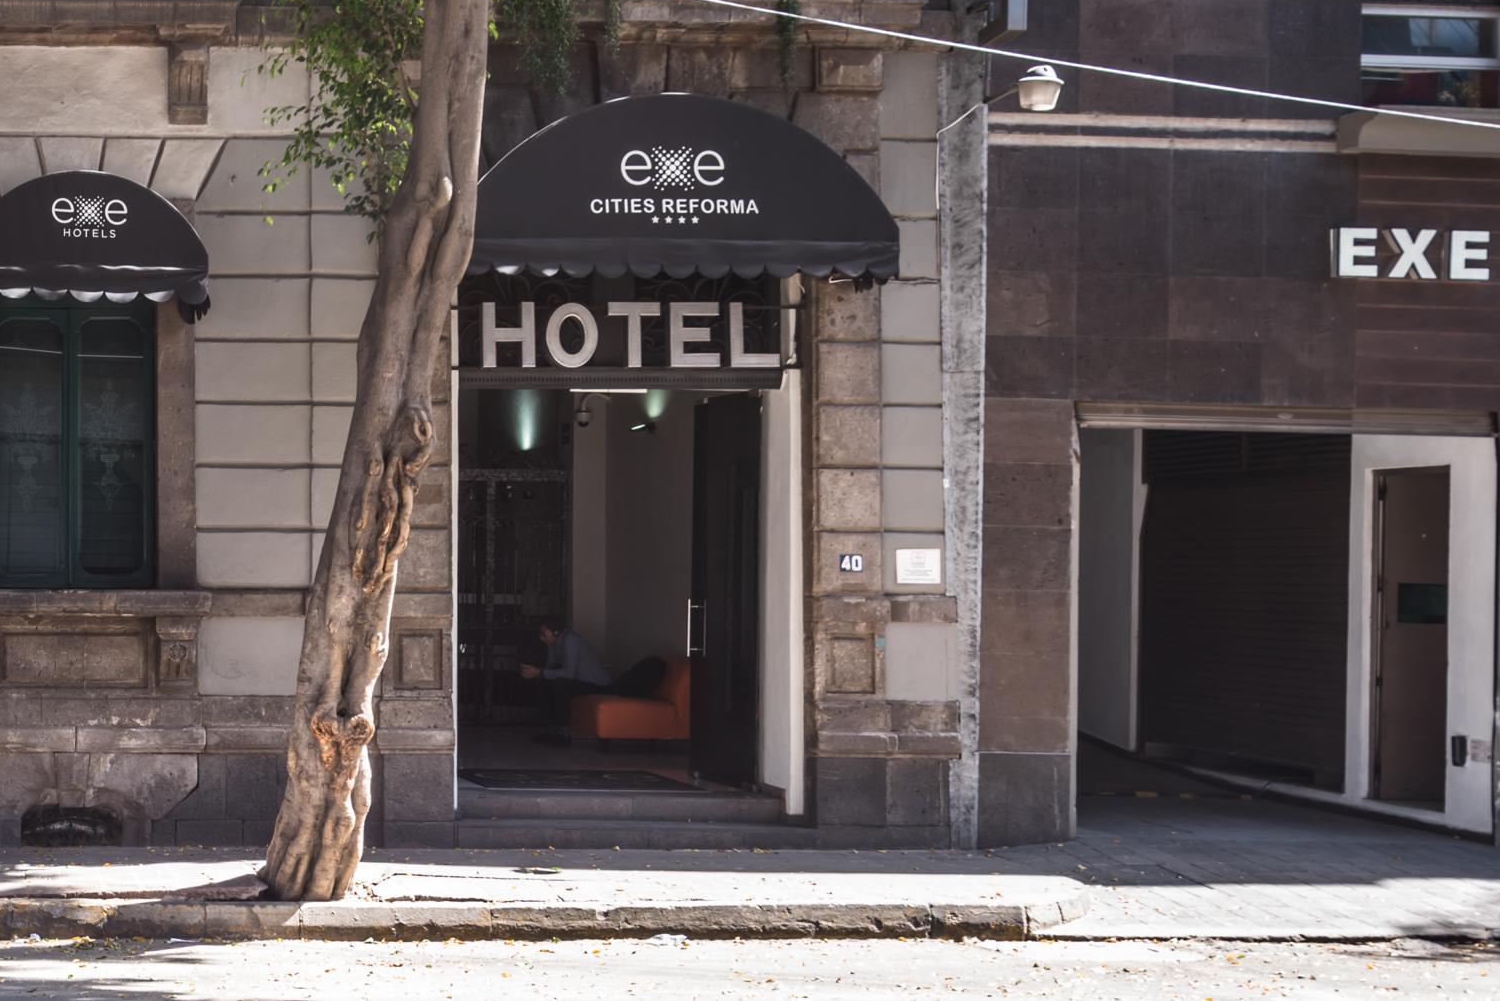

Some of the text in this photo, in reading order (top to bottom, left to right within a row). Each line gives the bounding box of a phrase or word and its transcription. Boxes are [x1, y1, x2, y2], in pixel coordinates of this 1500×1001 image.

[590, 198, 760, 215] CITIES REFORMA
[63, 228, 117, 239] HOTELS
[1335, 227, 1491, 281] EXE
[482, 301, 781, 368] HOTEL
[840, 554, 863, 572] 40
